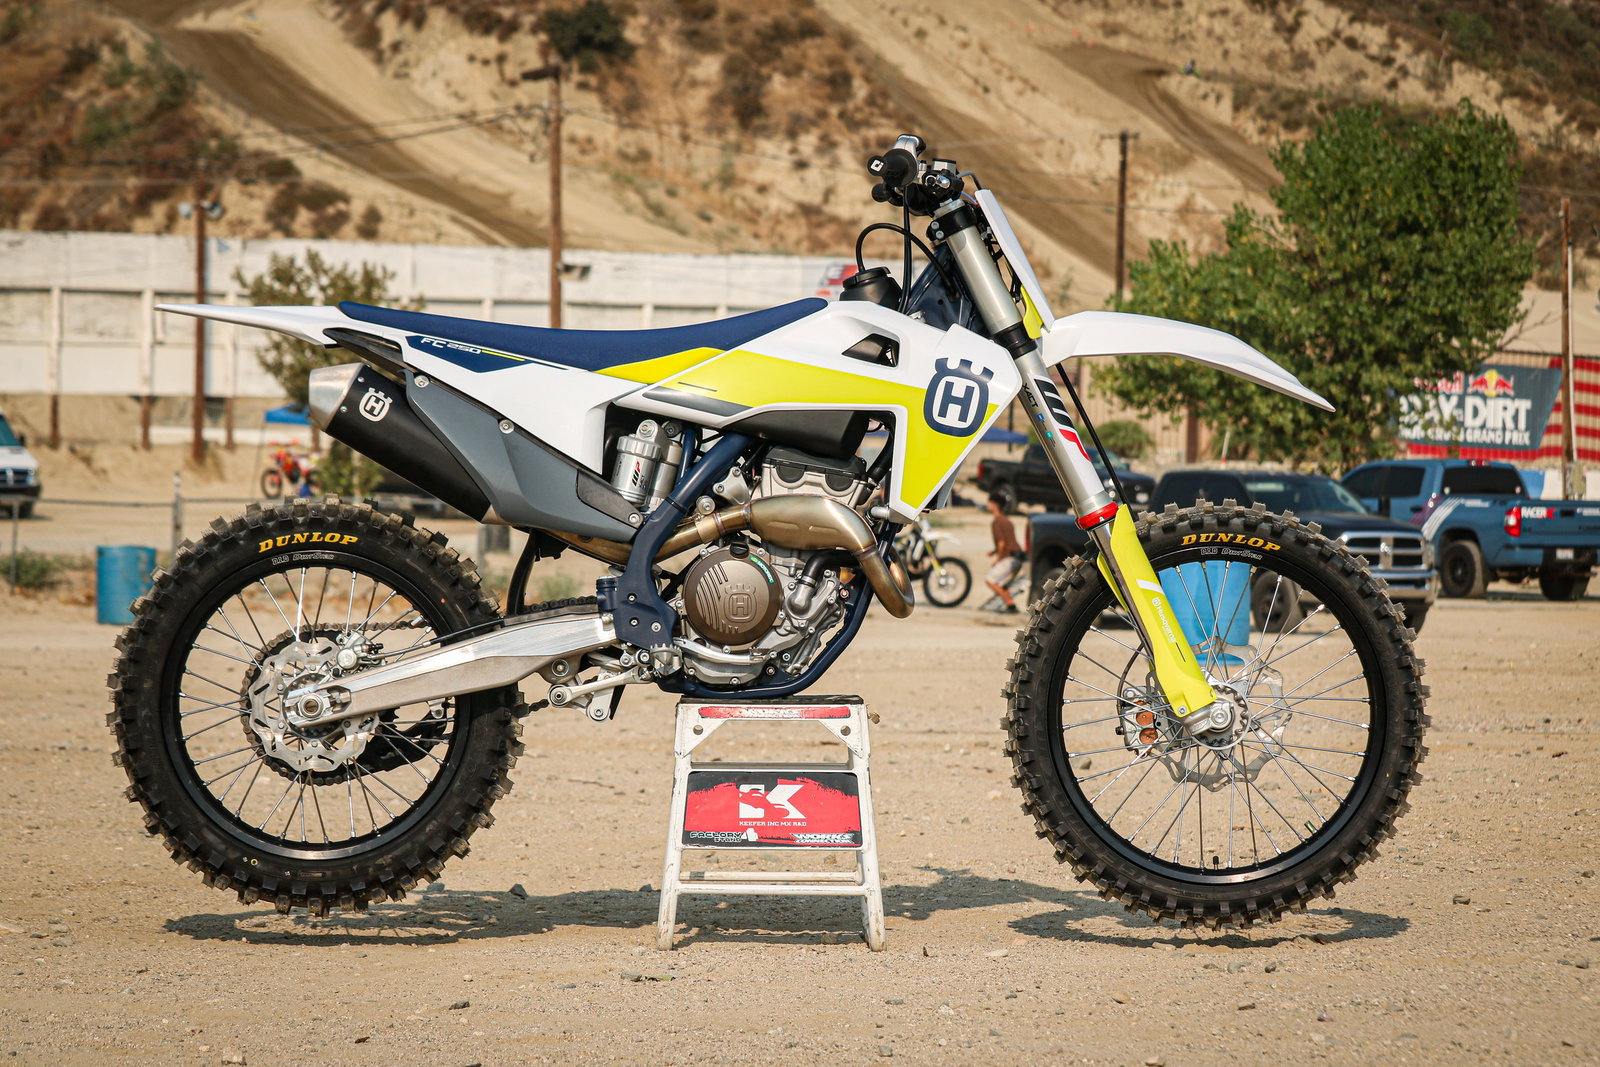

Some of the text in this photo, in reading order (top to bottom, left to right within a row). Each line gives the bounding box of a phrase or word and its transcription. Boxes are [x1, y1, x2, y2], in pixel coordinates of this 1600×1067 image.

[420, 337, 482, 354] FC 250
[1021, 382, 1039, 408] XACT
[1463, 395, 1532, 432] DIRT
[1465, 427, 1503, 444] GRAND
[1504, 430, 1531, 446] PRIX
[258, 531, 359, 553] DUNLOP
[1180, 532, 1281, 551] DUNLOP
